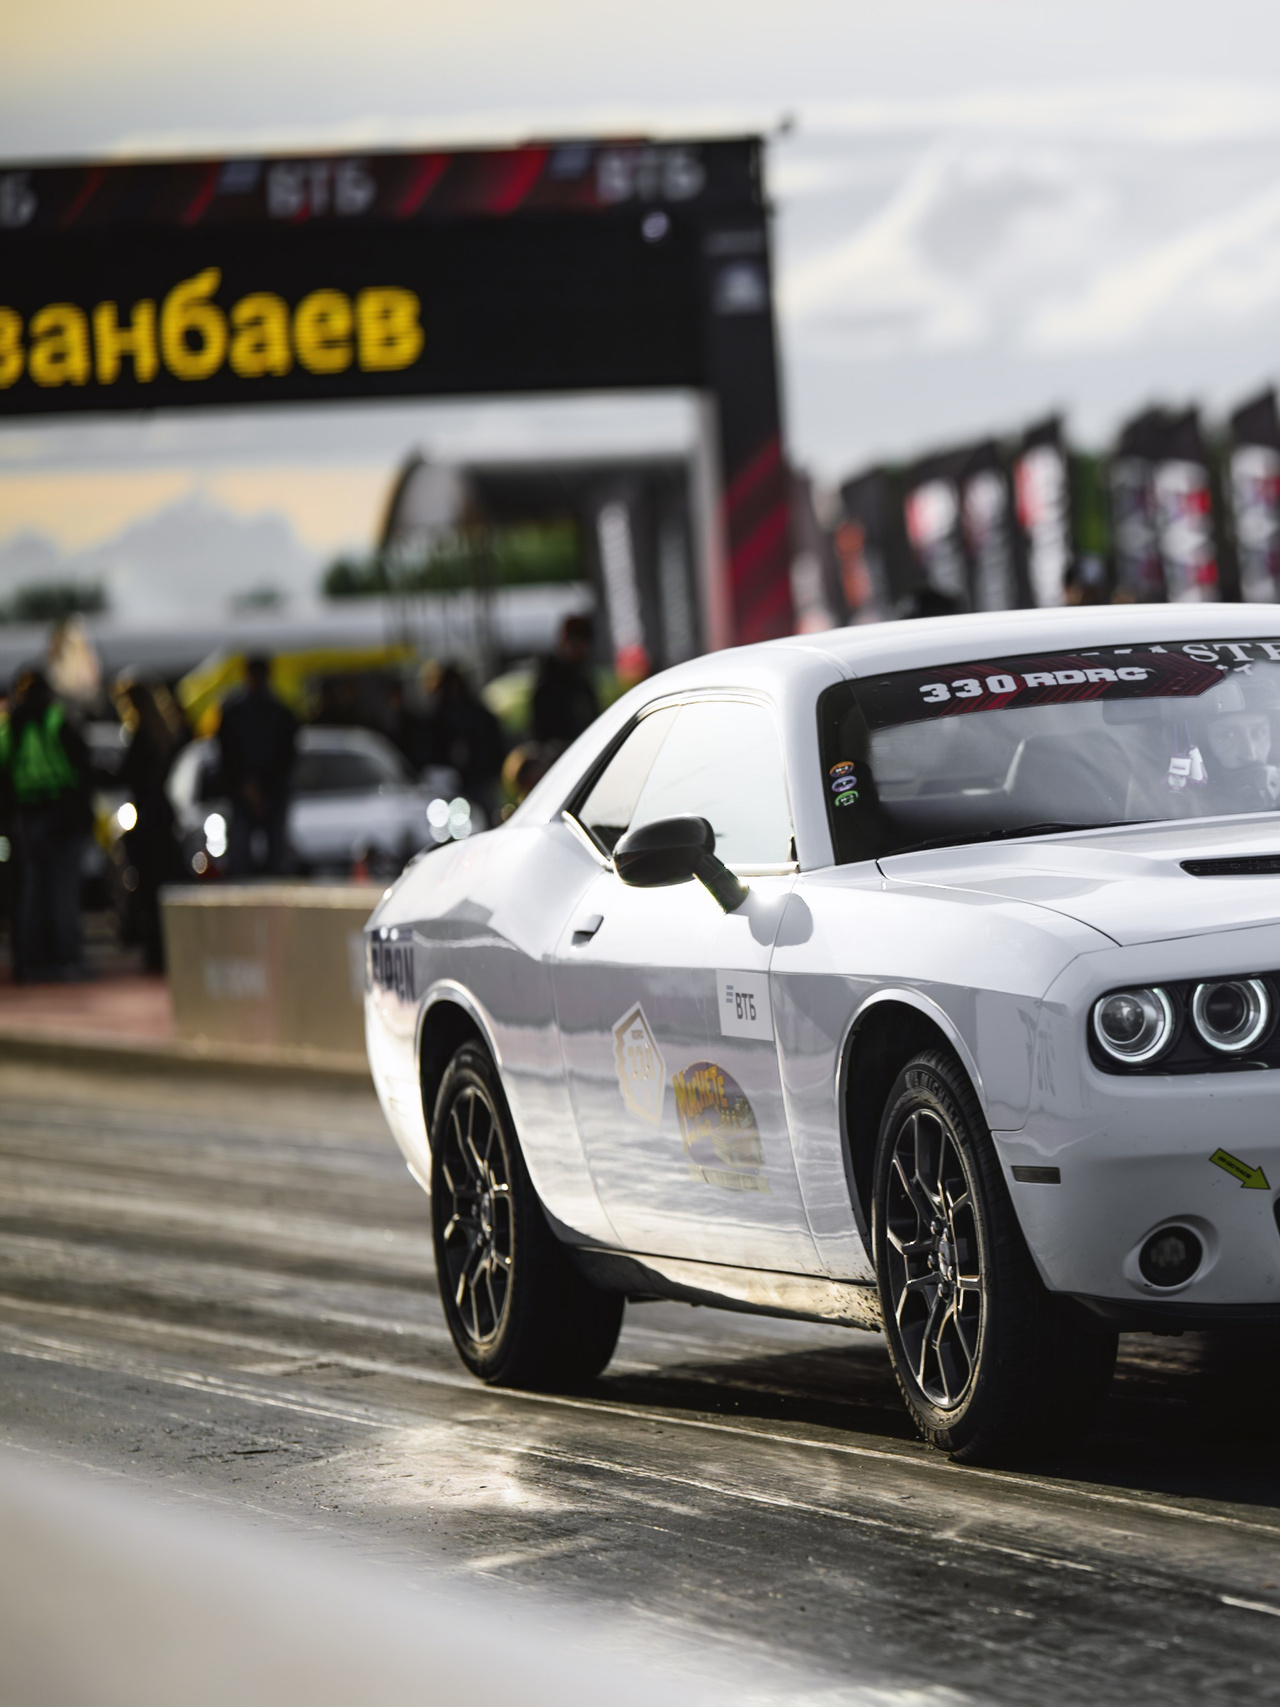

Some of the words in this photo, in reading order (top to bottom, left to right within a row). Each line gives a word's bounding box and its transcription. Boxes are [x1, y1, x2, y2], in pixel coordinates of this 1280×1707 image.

[919, 675, 1017, 703] 330
[1021, 667, 1148, 688] RDRC
[735, 992, 757, 1021] ВТБ
